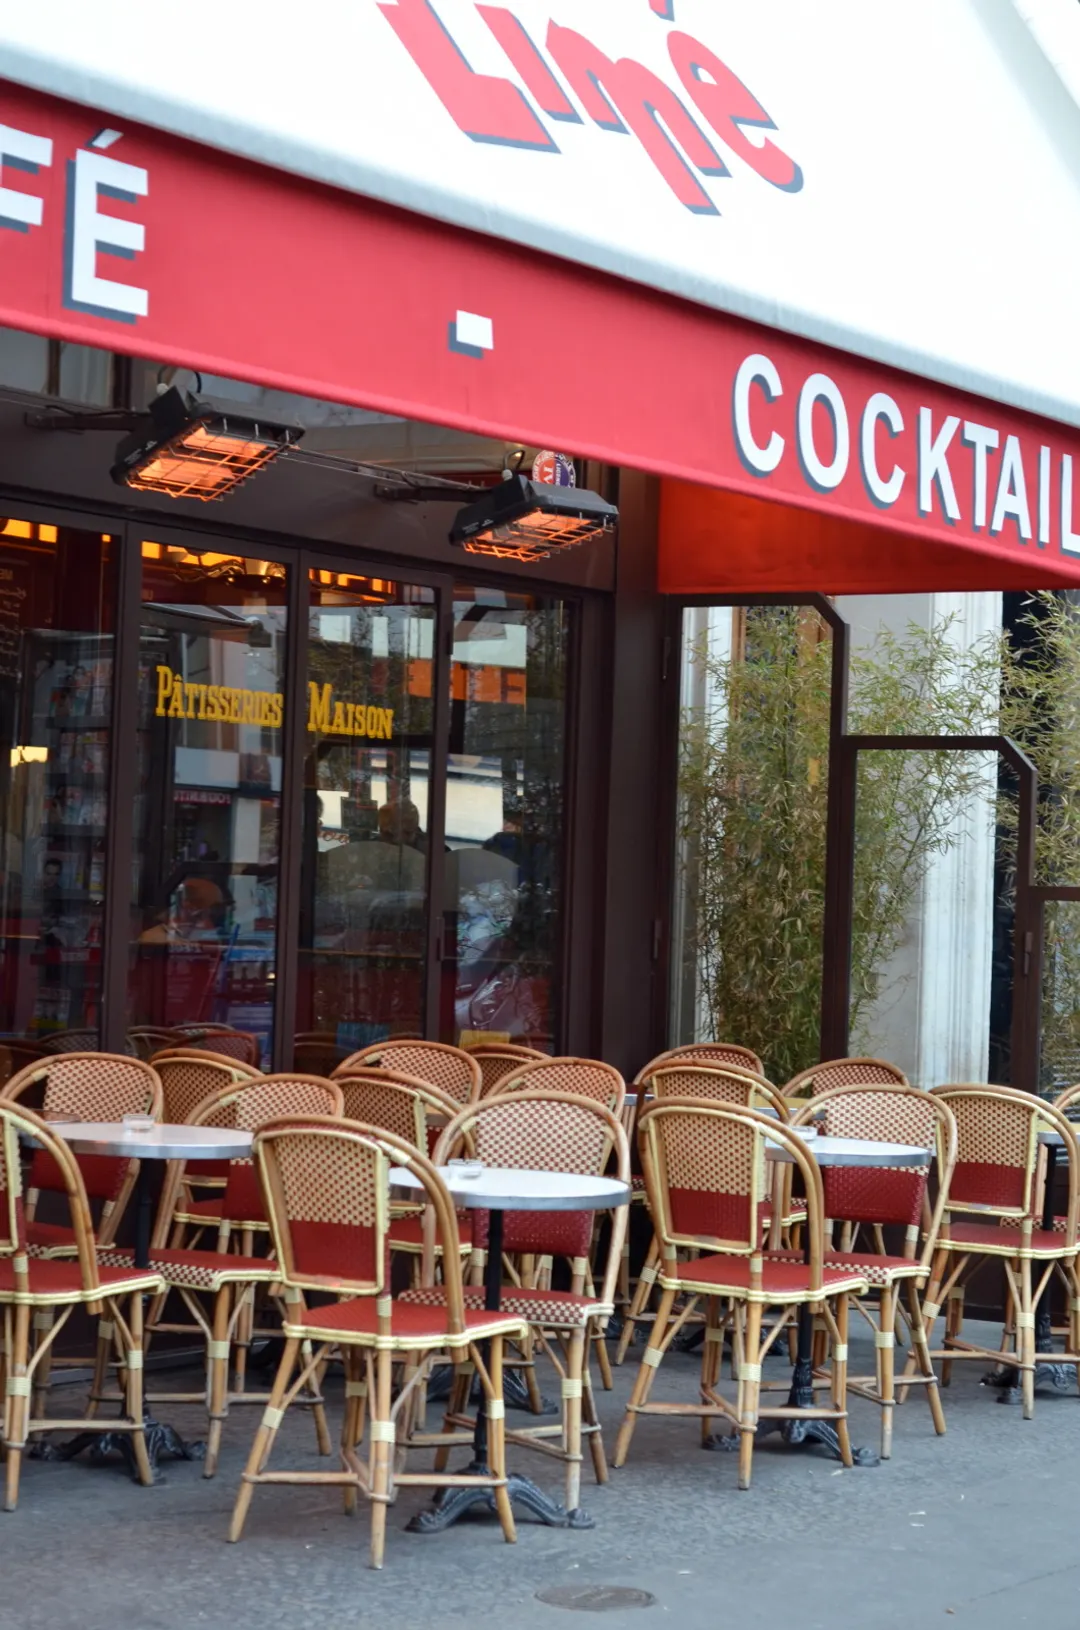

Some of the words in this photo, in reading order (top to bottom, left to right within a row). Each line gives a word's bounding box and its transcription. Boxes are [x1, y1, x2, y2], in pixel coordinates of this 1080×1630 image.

[733, 353, 1080, 557] COCKTAIL
[156, 665, 284, 728] PÂTISSERIES
[307, 681, 394, 739] MAISON
